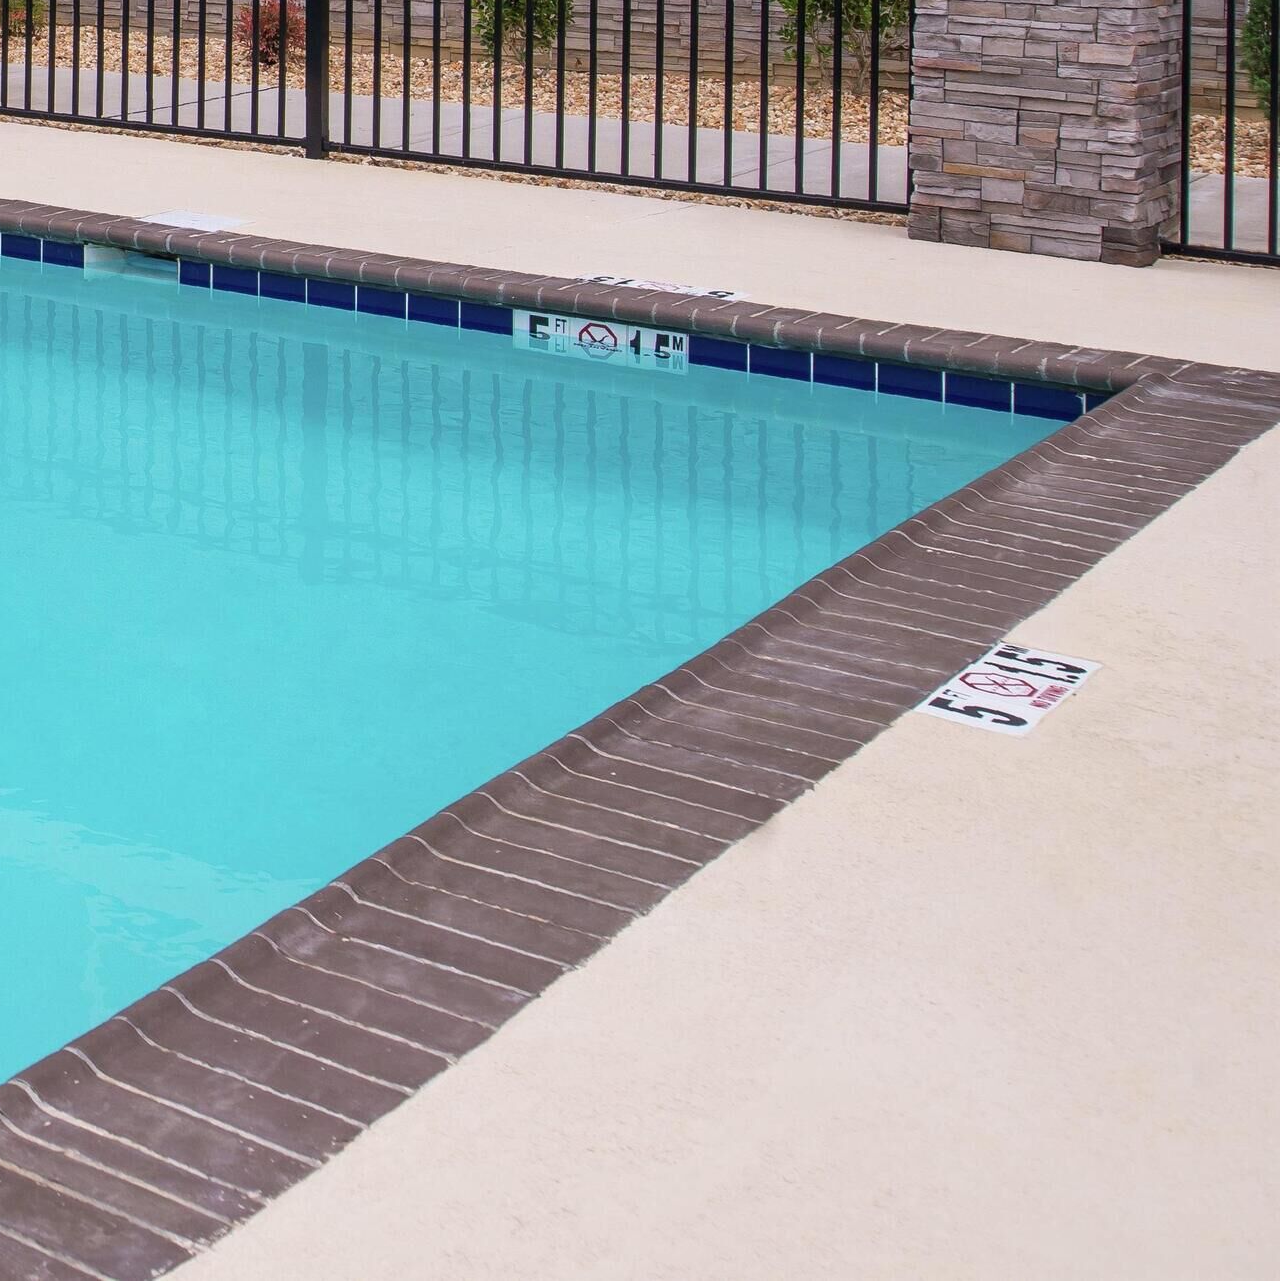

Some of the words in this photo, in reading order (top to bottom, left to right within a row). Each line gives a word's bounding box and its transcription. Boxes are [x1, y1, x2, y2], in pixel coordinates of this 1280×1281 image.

[529, 315, 550, 340] 5
[555, 318, 567, 334] FT
[672, 336, 683, 352] M
